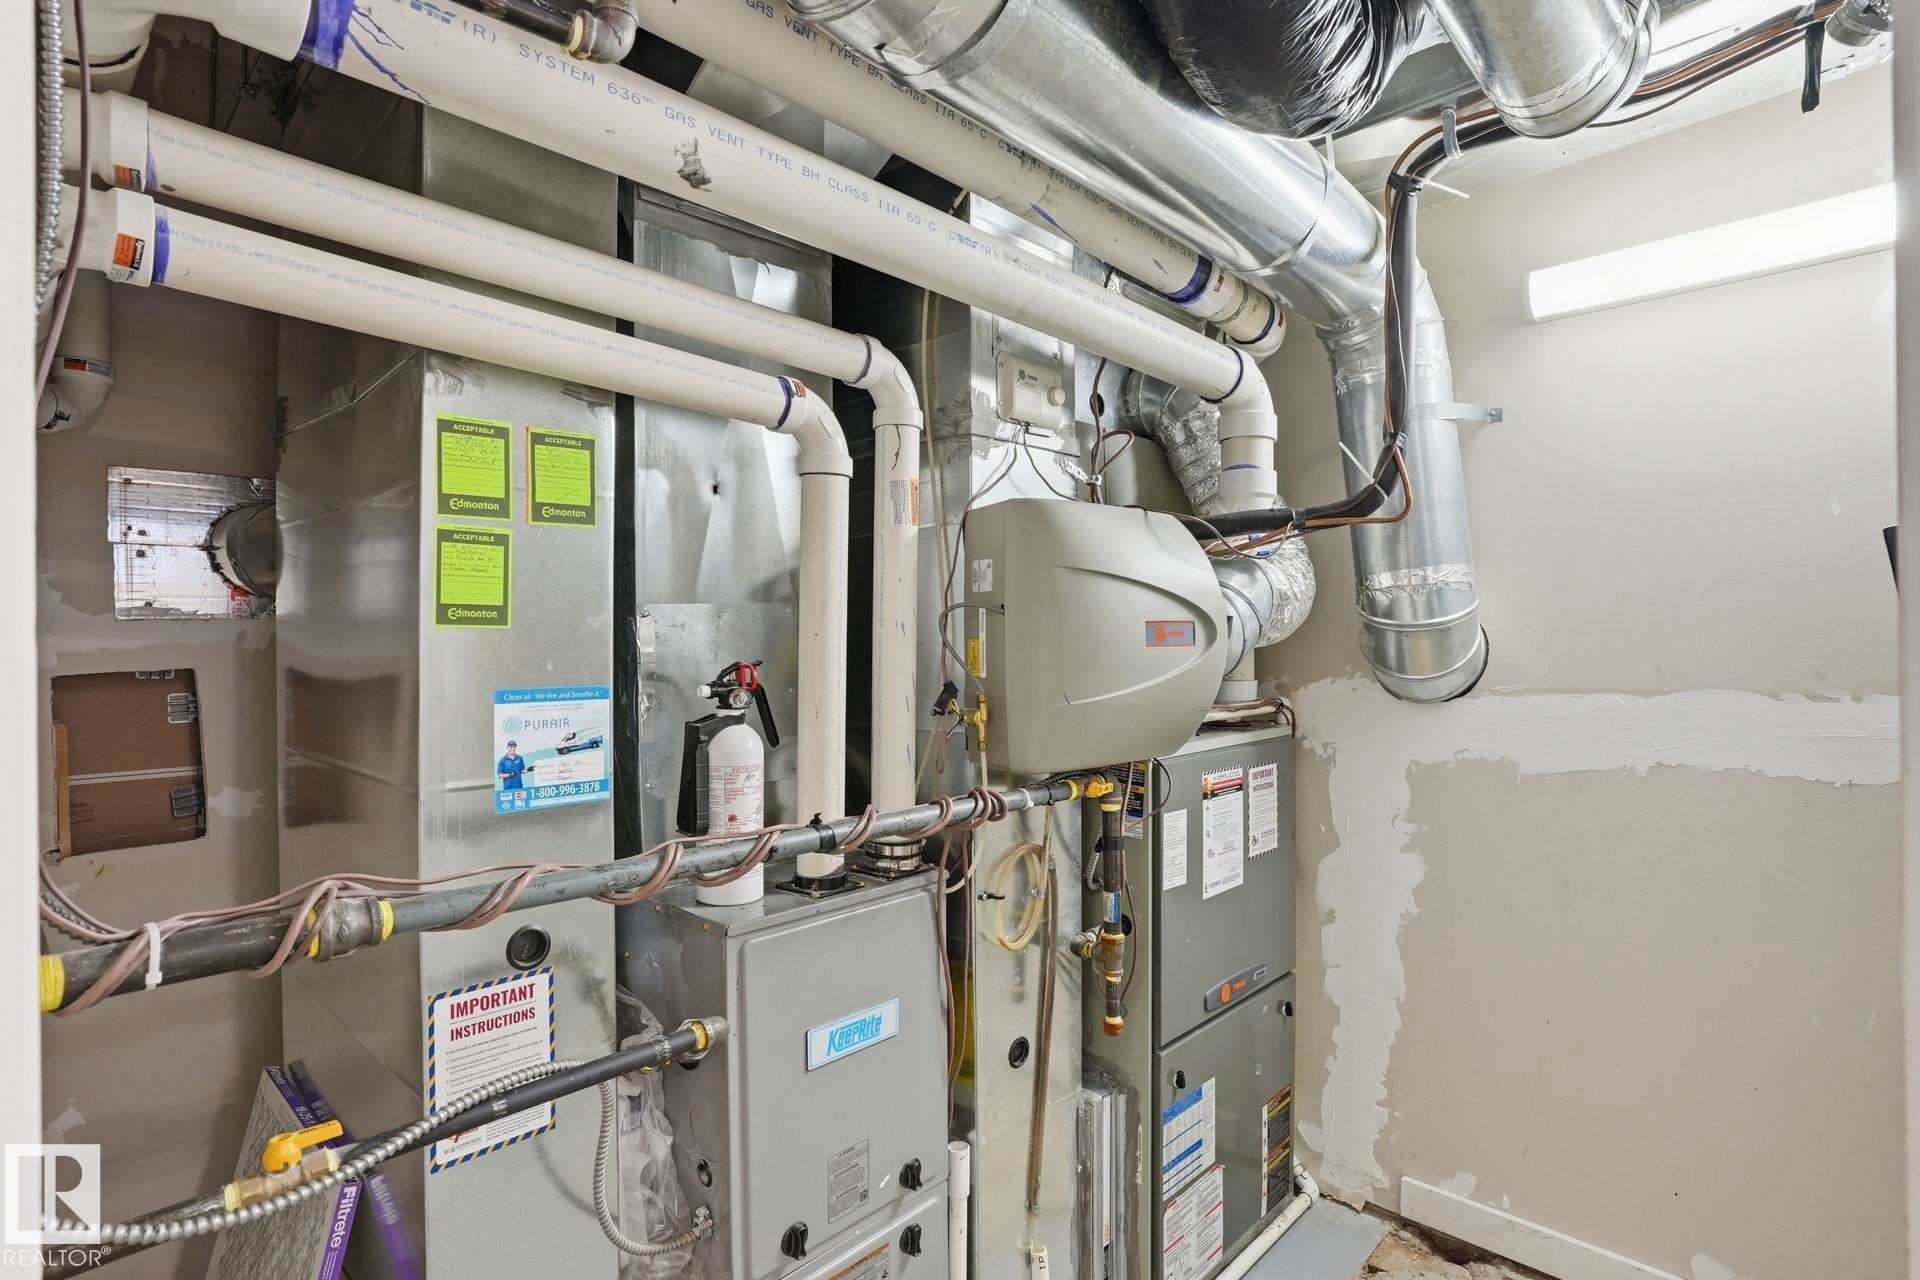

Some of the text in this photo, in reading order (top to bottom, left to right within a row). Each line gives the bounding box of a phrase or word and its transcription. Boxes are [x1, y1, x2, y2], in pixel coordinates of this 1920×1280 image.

[747, 0, 774, 18] GAS
[785, 15, 820, 43] VENT
[829, 41, 859, 68] TYPE
[867, 64, 884, 81] BH
[934, 102, 955, 121] IIA
[518, 43, 595, 87] SYSTEM
[664, 105, 697, 129] GAS
[708, 124, 747, 150] VENT
[757, 145, 793, 171] TYPE
[802, 166, 820, 182] BH
[828, 177, 869, 202] CLASS
[877, 199, 901, 216] IIA
[906, 210, 937, 232] 65°C
[154, 131, 176, 145] Gas
[179, 138, 200, 151] Vent
[244, 158, 268, 174] Class
[1048, 167, 1080, 194] SYSTEM
[1107, 203, 1126, 219] GAS
[1127, 214, 1145, 231] VENT
[1149, 228, 1166, 244] TYPE
[181, 230, 206, 246] Class
[216, 240, 223, 249] A
[266, 252, 303, 271] SYSTEM
[453, 423, 495, 435] ACCEPTABLE
[544, 436, 582, 447] ACCEPTABLE
[449, 497, 500, 511] Edmonton
[541, 506, 586, 518] Edmonton
[452, 533, 495, 543] ACCEPTABLE
[447, 607, 498, 620] Edmonton
[503, 692, 523, 701] Clean
[546, 691, 557, 699] live
[558, 690, 571, 699] and
[571, 690, 594, 698] breathe
[524, 717, 571, 731] PURAIR
[529, 781, 601, 799] 1-800-996-3878
[450, 983, 536, 1020] IMPORTANT
[450, 1006, 536, 1042] INSTRUCTIONS
[826, 1013, 882, 1057] KeepRite
[330, 1185, 358, 1249] Filtrete
